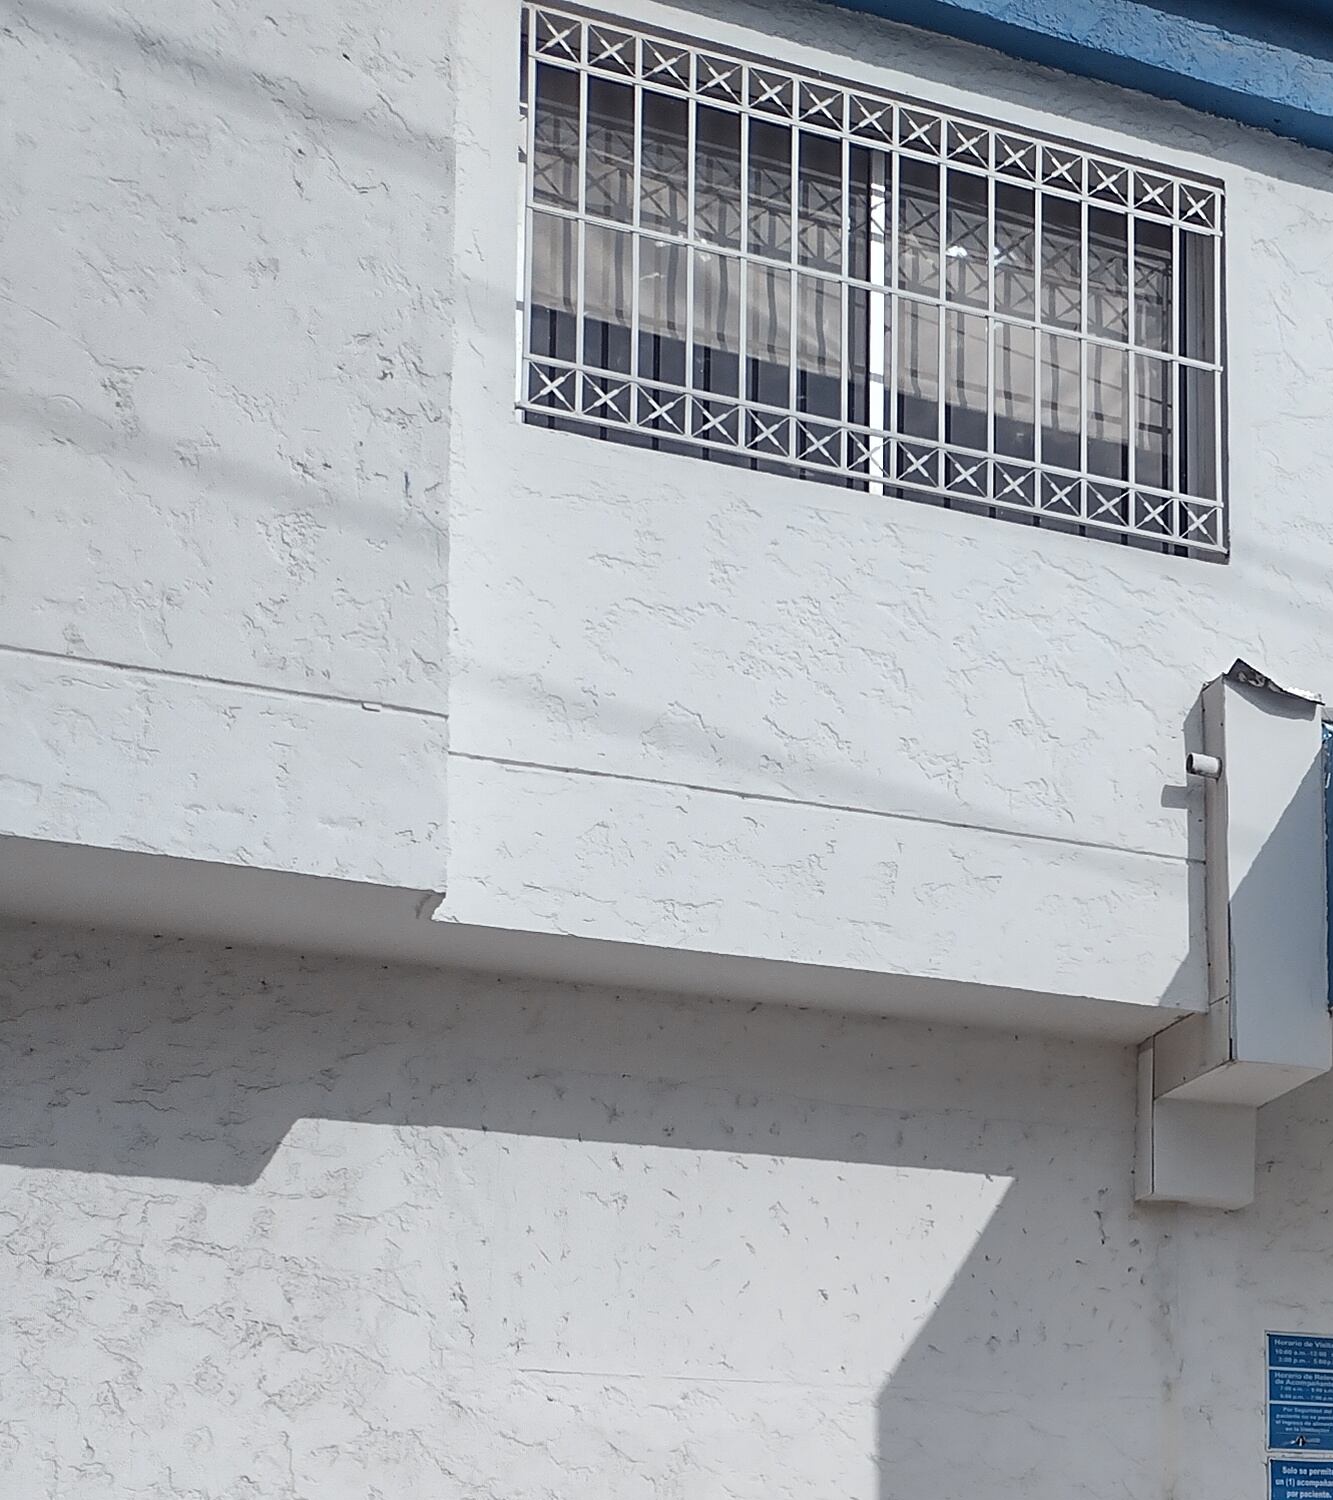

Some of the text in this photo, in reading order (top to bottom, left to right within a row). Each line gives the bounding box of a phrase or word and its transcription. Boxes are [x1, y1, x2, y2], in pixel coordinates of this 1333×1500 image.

[1274, 1339, 1302, 1347] Horario
[1274, 1372, 1302, 1380] Horario
[1282, 1466, 1298, 1474] Solo
[1285, 1478, 1295, 1487] (1)
